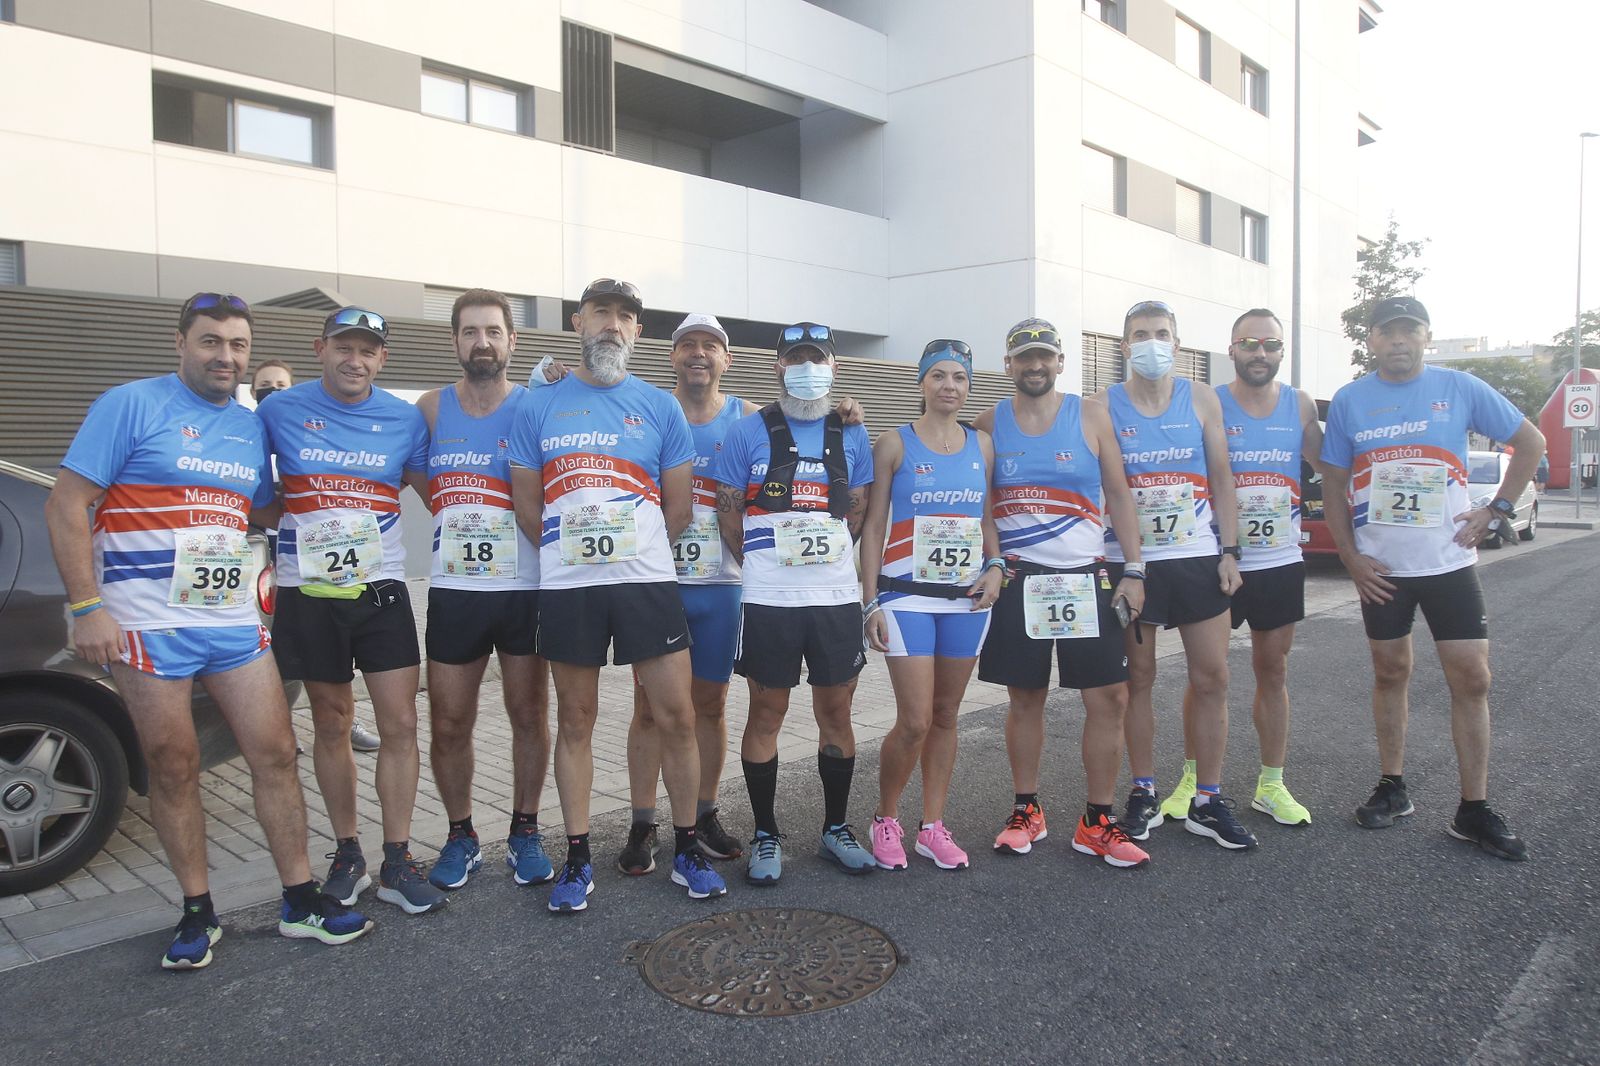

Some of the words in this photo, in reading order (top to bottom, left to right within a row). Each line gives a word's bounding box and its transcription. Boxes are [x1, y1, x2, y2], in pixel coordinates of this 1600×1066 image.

[1573, 403, 1589, 413] 30
[1354, 420, 1428, 442] enerplus
[541, 431, 619, 451] enerplus
[299, 447, 388, 467] enerplus
[1122, 447, 1193, 464] enerplus
[1228, 448, 1293, 464] enerplus
[1366, 445, 1422, 463] Maratón
[176, 455, 256, 481] enerplus
[555, 456, 614, 473] Maratón
[309, 476, 375, 494] Maratón
[438, 474, 487, 488] Maratón
[562, 474, 612, 492] Lucena
[1131, 473, 1187, 489] Maratón
[185, 488, 244, 510] Maratón
[318, 495, 372, 511] Lucena
[441, 493, 484, 507] Lucena
[911, 488, 983, 505] enerplus
[1000, 487, 1048, 500] Maratón
[1392, 492, 1421, 512] 21
[1004, 504, 1046, 515] Lucena
[189, 510, 240, 529] Lucena
[1152, 514, 1178, 534] 17
[1247, 519, 1275, 537] 26
[463, 541, 494, 562] 18
[581, 535, 614, 558] 30
[673, 542, 701, 562] 19
[800, 535, 830, 557] 25
[324, 548, 360, 573] 24
[928, 548, 971, 567] 452
[192, 566, 241, 590] 398
[1047, 603, 1076, 623] 16
